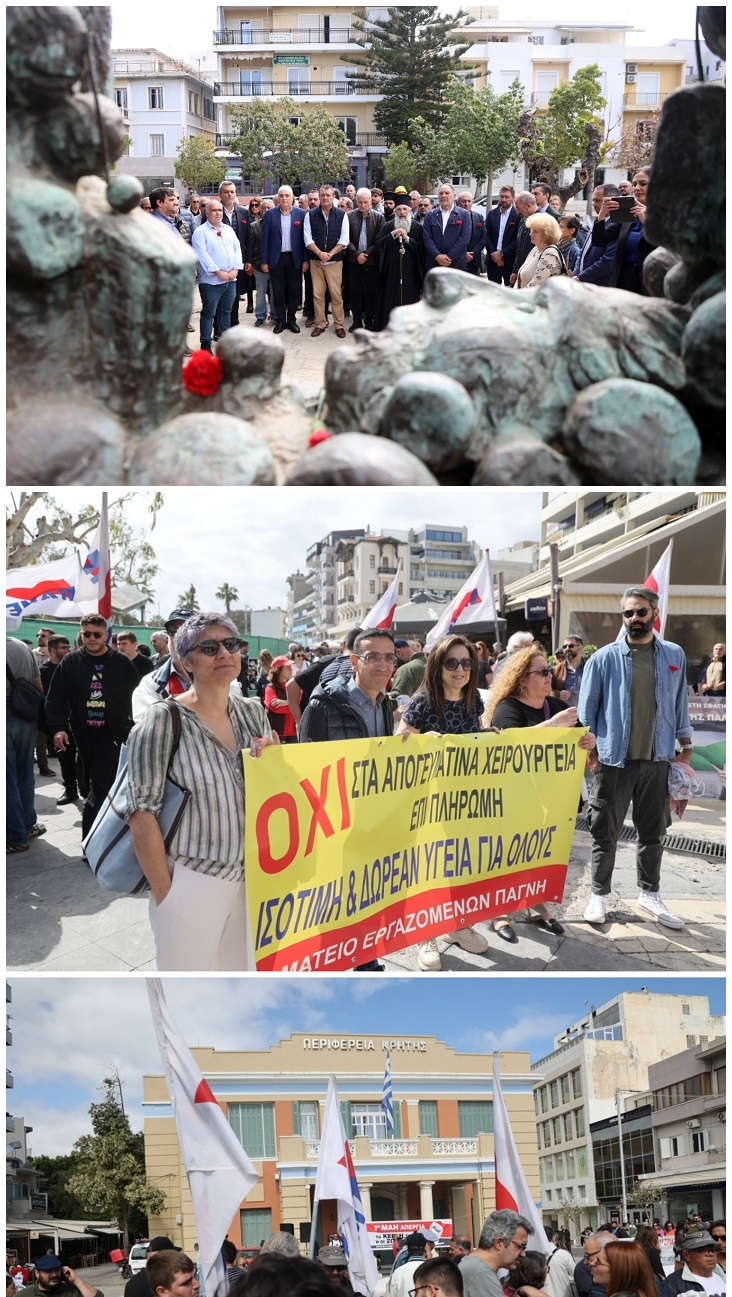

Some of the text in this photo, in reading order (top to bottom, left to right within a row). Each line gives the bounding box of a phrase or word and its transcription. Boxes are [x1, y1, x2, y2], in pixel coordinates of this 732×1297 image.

[351, 743, 576, 799] ΣΤΑ ΑΠΟΓΕΥΜΑΤΙΝΑ ΧΕΙΡΟΥΡΓΕΙΑ
[255, 756, 351, 875] ΟΧΙ
[410, 788, 503, 831] ΕΠΙ ΠΛΗΡΩΜΗ
[255, 825, 556, 951] ΙΣΟΤΙΜΗ & ΔΩΡΕΑΝ ΥΓΕΙΑ ΓΙΑ ΟΛΟΥΣ
[362, 892, 490, 950] ΕΡΓΑΖΟΜΕΝΩΝ
[495, 879, 547, 905] ΠΑΓΝΗ
[303, 1038, 427, 1052] ΠΕΡΙΦΕΡΕΙΑ ΚΡΗΤΗΣ
